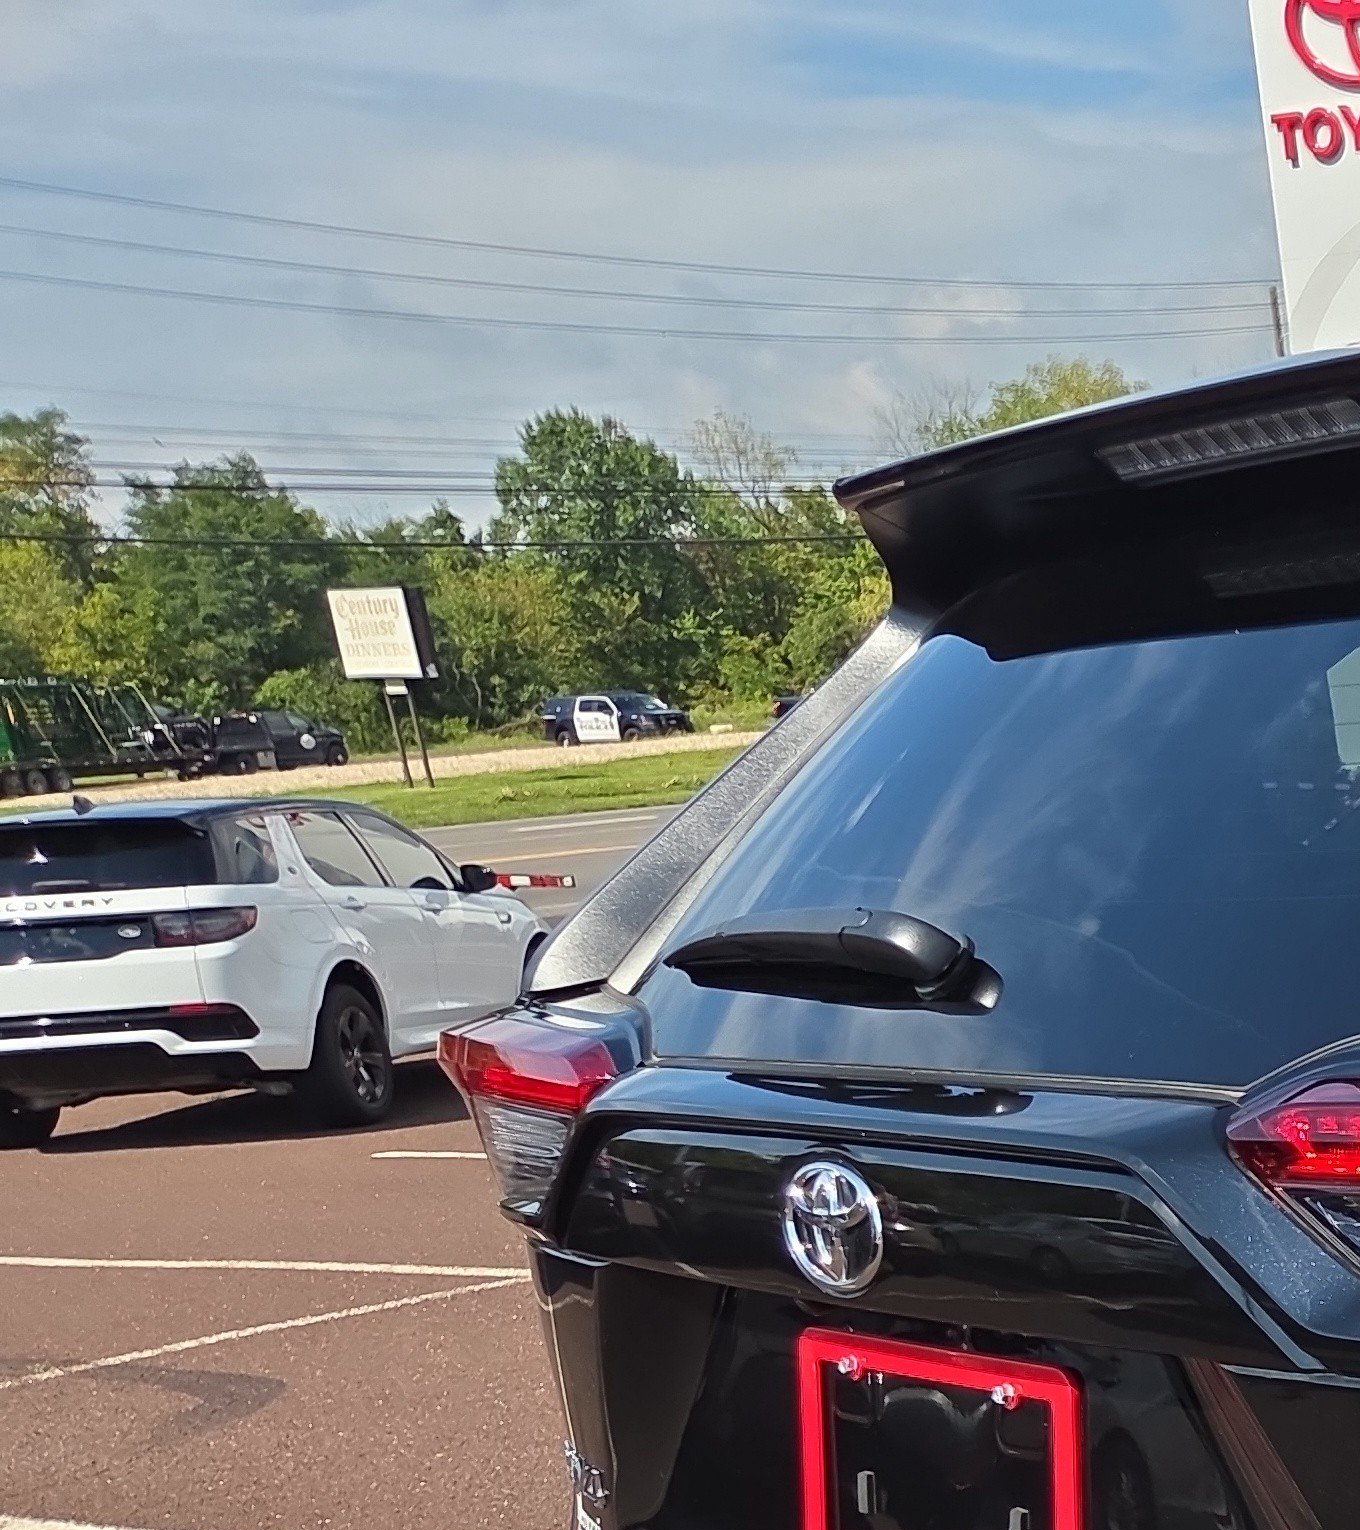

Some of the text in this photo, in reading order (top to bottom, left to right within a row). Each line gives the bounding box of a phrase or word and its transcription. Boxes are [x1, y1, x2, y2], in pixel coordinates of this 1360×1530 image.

[335, 594, 400, 620] Century
[345, 617, 396, 640] House
[346, 642, 412, 657] DINNERS
